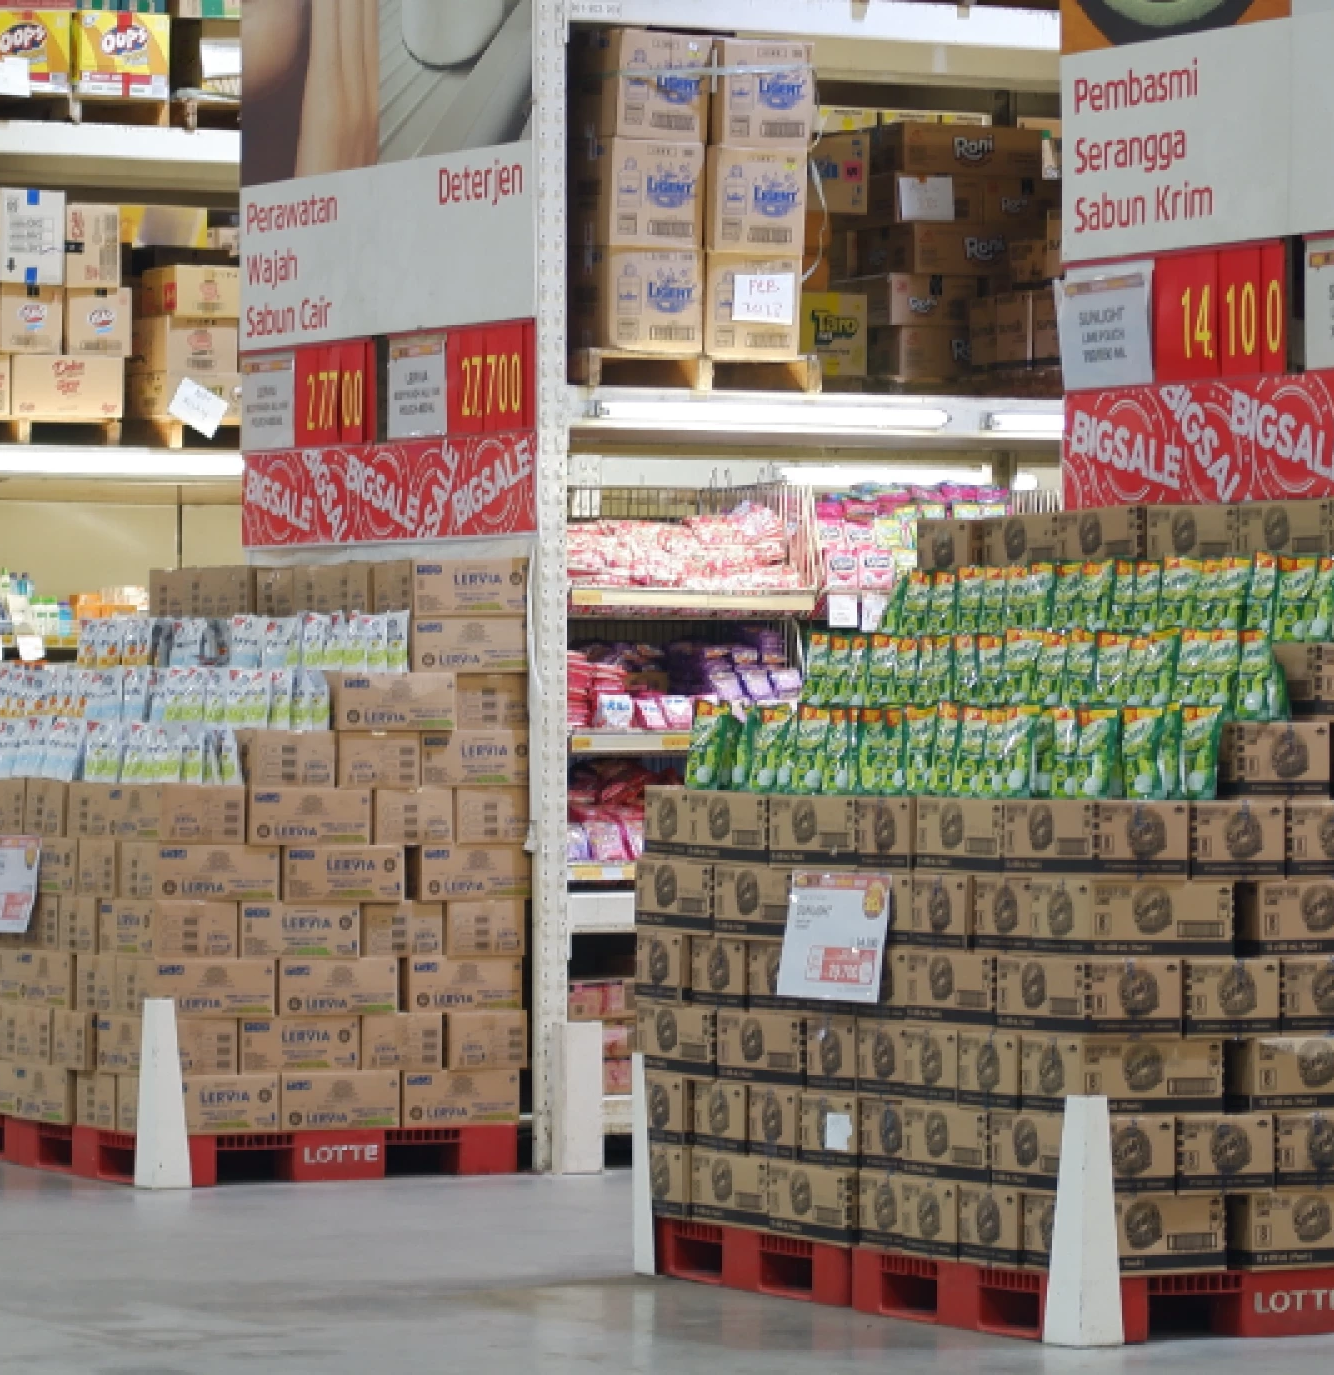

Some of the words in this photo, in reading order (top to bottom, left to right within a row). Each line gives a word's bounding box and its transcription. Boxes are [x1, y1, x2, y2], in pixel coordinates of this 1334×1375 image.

[1074, 57, 1198, 115] Pembasmi
[1074, 129, 1186, 175] Serangga
[439, 158, 522, 206] Deterjen
[1074, 191, 1147, 234] Sabun
[1155, 180, 1213, 223] Krim
[247, 193, 337, 235] Perawatan
[247, 248, 297, 290] Wajah
[247, 303, 295, 338] Sabun
[300, 295, 332, 331] Cair
[1071, 410, 1182, 490] BIGSALE
[247, 469, 313, 531] BIGSALE
[346, 452, 419, 532] BIGSALE
[451, 438, 534, 530] BIGSALE
[304, 1144, 379, 1165] LOTTE
